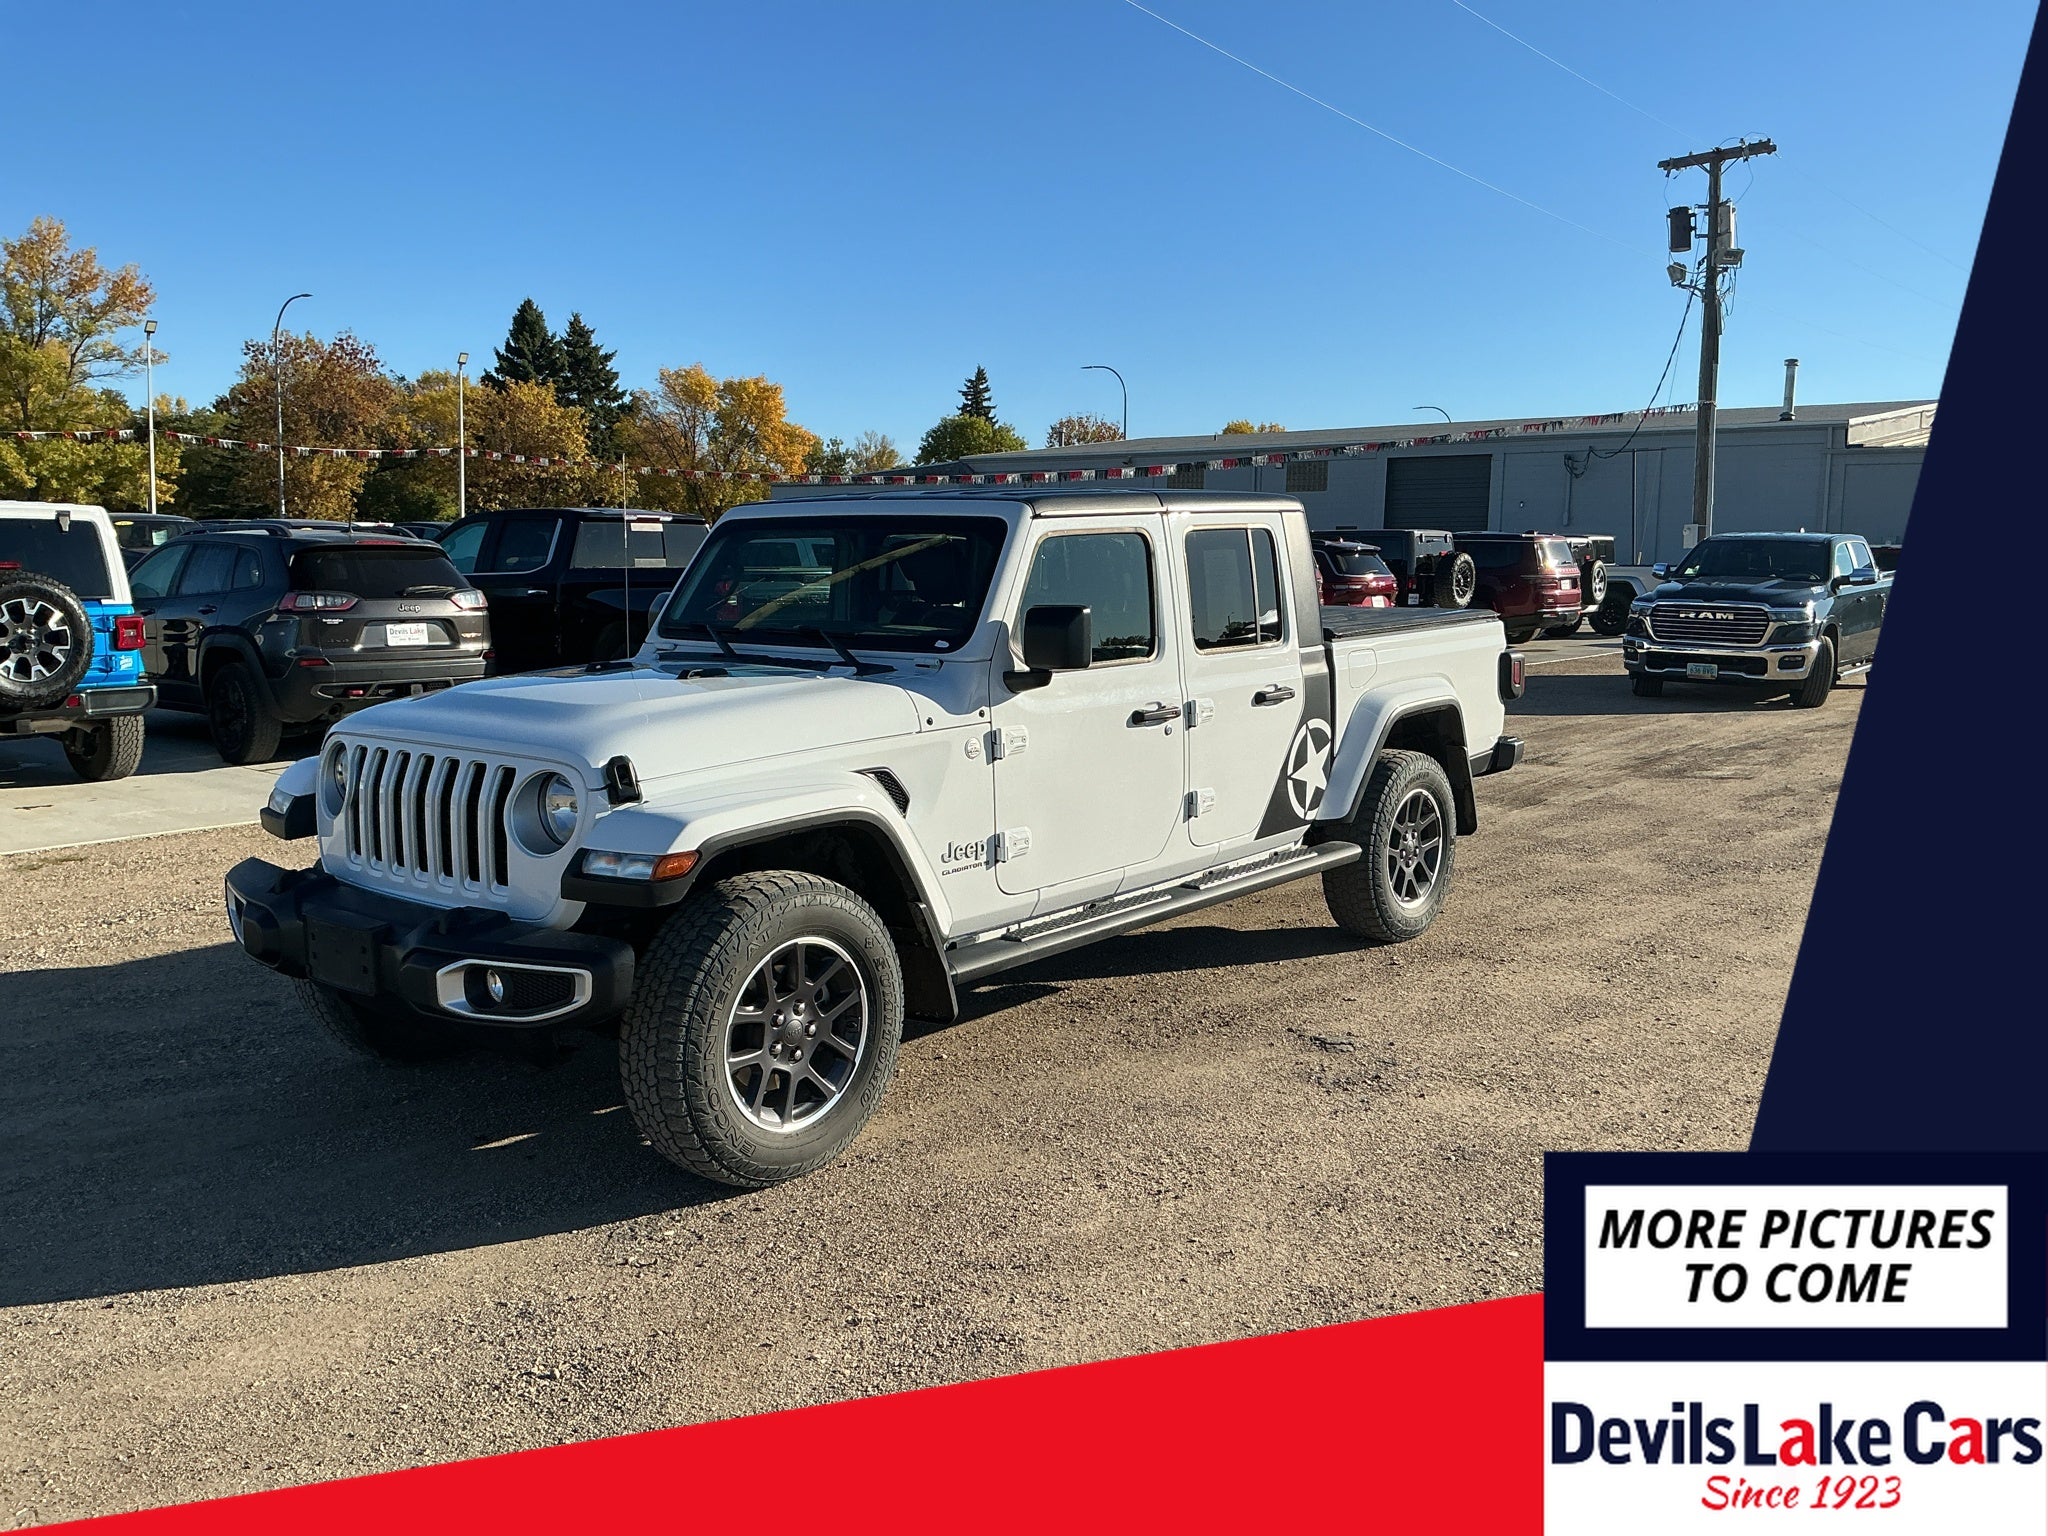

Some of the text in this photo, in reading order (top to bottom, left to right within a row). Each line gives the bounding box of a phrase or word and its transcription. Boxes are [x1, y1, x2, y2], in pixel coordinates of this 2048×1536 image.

[398, 603, 421, 613] Jeep
[1679, 611, 1734, 619] RAM
[941, 840, 985, 863] Jeep
[941, 862, 982, 876] GLADIATOR
[860, 956, 893, 1108] SUMITOMO
[702, 966, 757, 1157] ENCOUNTER
